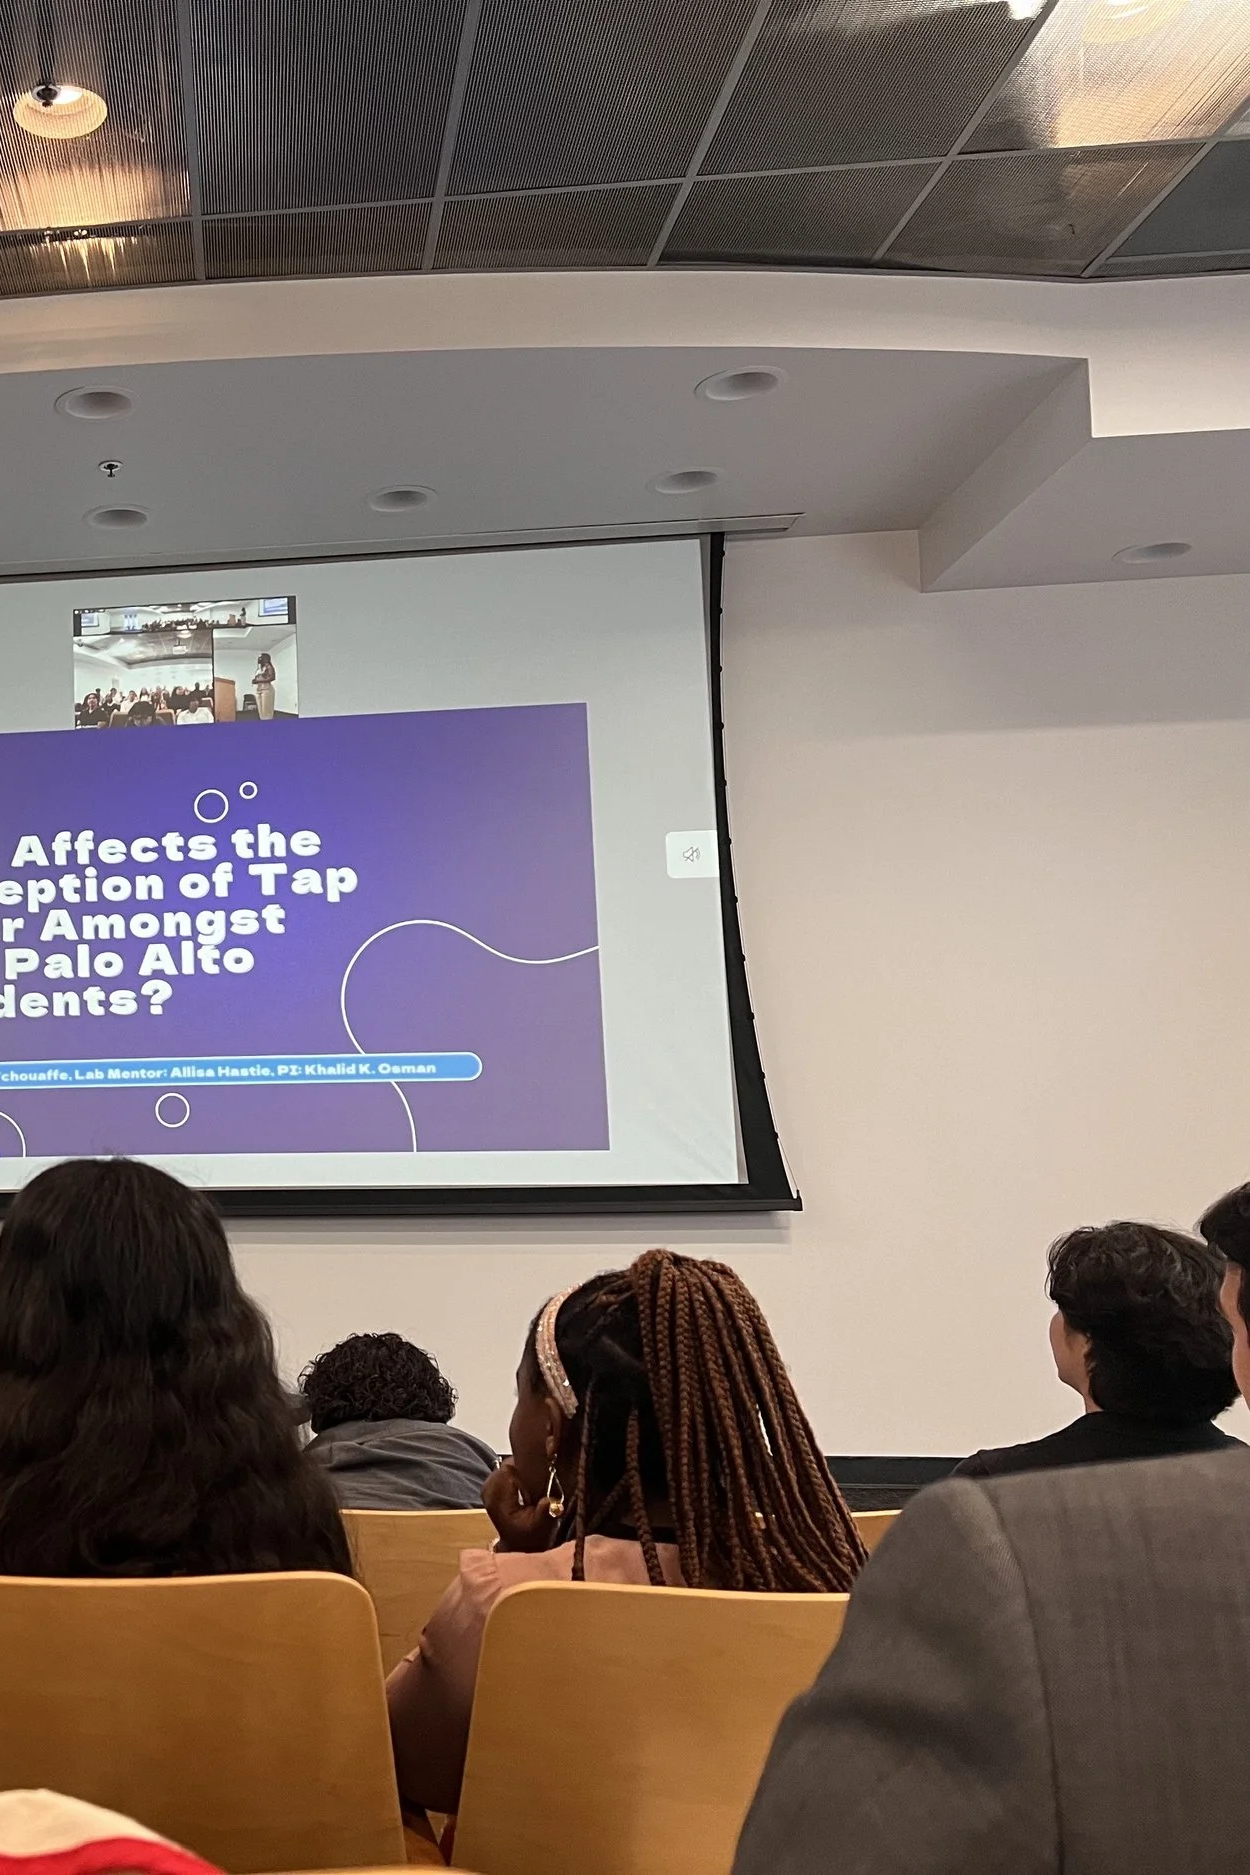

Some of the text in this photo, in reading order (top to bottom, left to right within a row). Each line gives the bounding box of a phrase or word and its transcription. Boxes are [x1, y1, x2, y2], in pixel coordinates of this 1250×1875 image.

[10, 829, 218, 868] Affects
[230, 823, 322, 859] the
[178, 861, 234, 899] of
[248, 862, 359, 903] Tap
[39, 903, 287, 945] Amongst
[4, 943, 124, 981] Palo
[138, 940, 256, 977] Alto
[74, 1068, 105, 1080] Lab
[107, 1068, 169, 1080] Mentor:
[170, 1066, 216, 1078] Allisa
[277, 1064, 303, 1077] PI:
[304, 1063, 357, 1076] Khalid
[358, 1063, 376, 1075] K.
[377, 1062, 437, 1074] Osman
